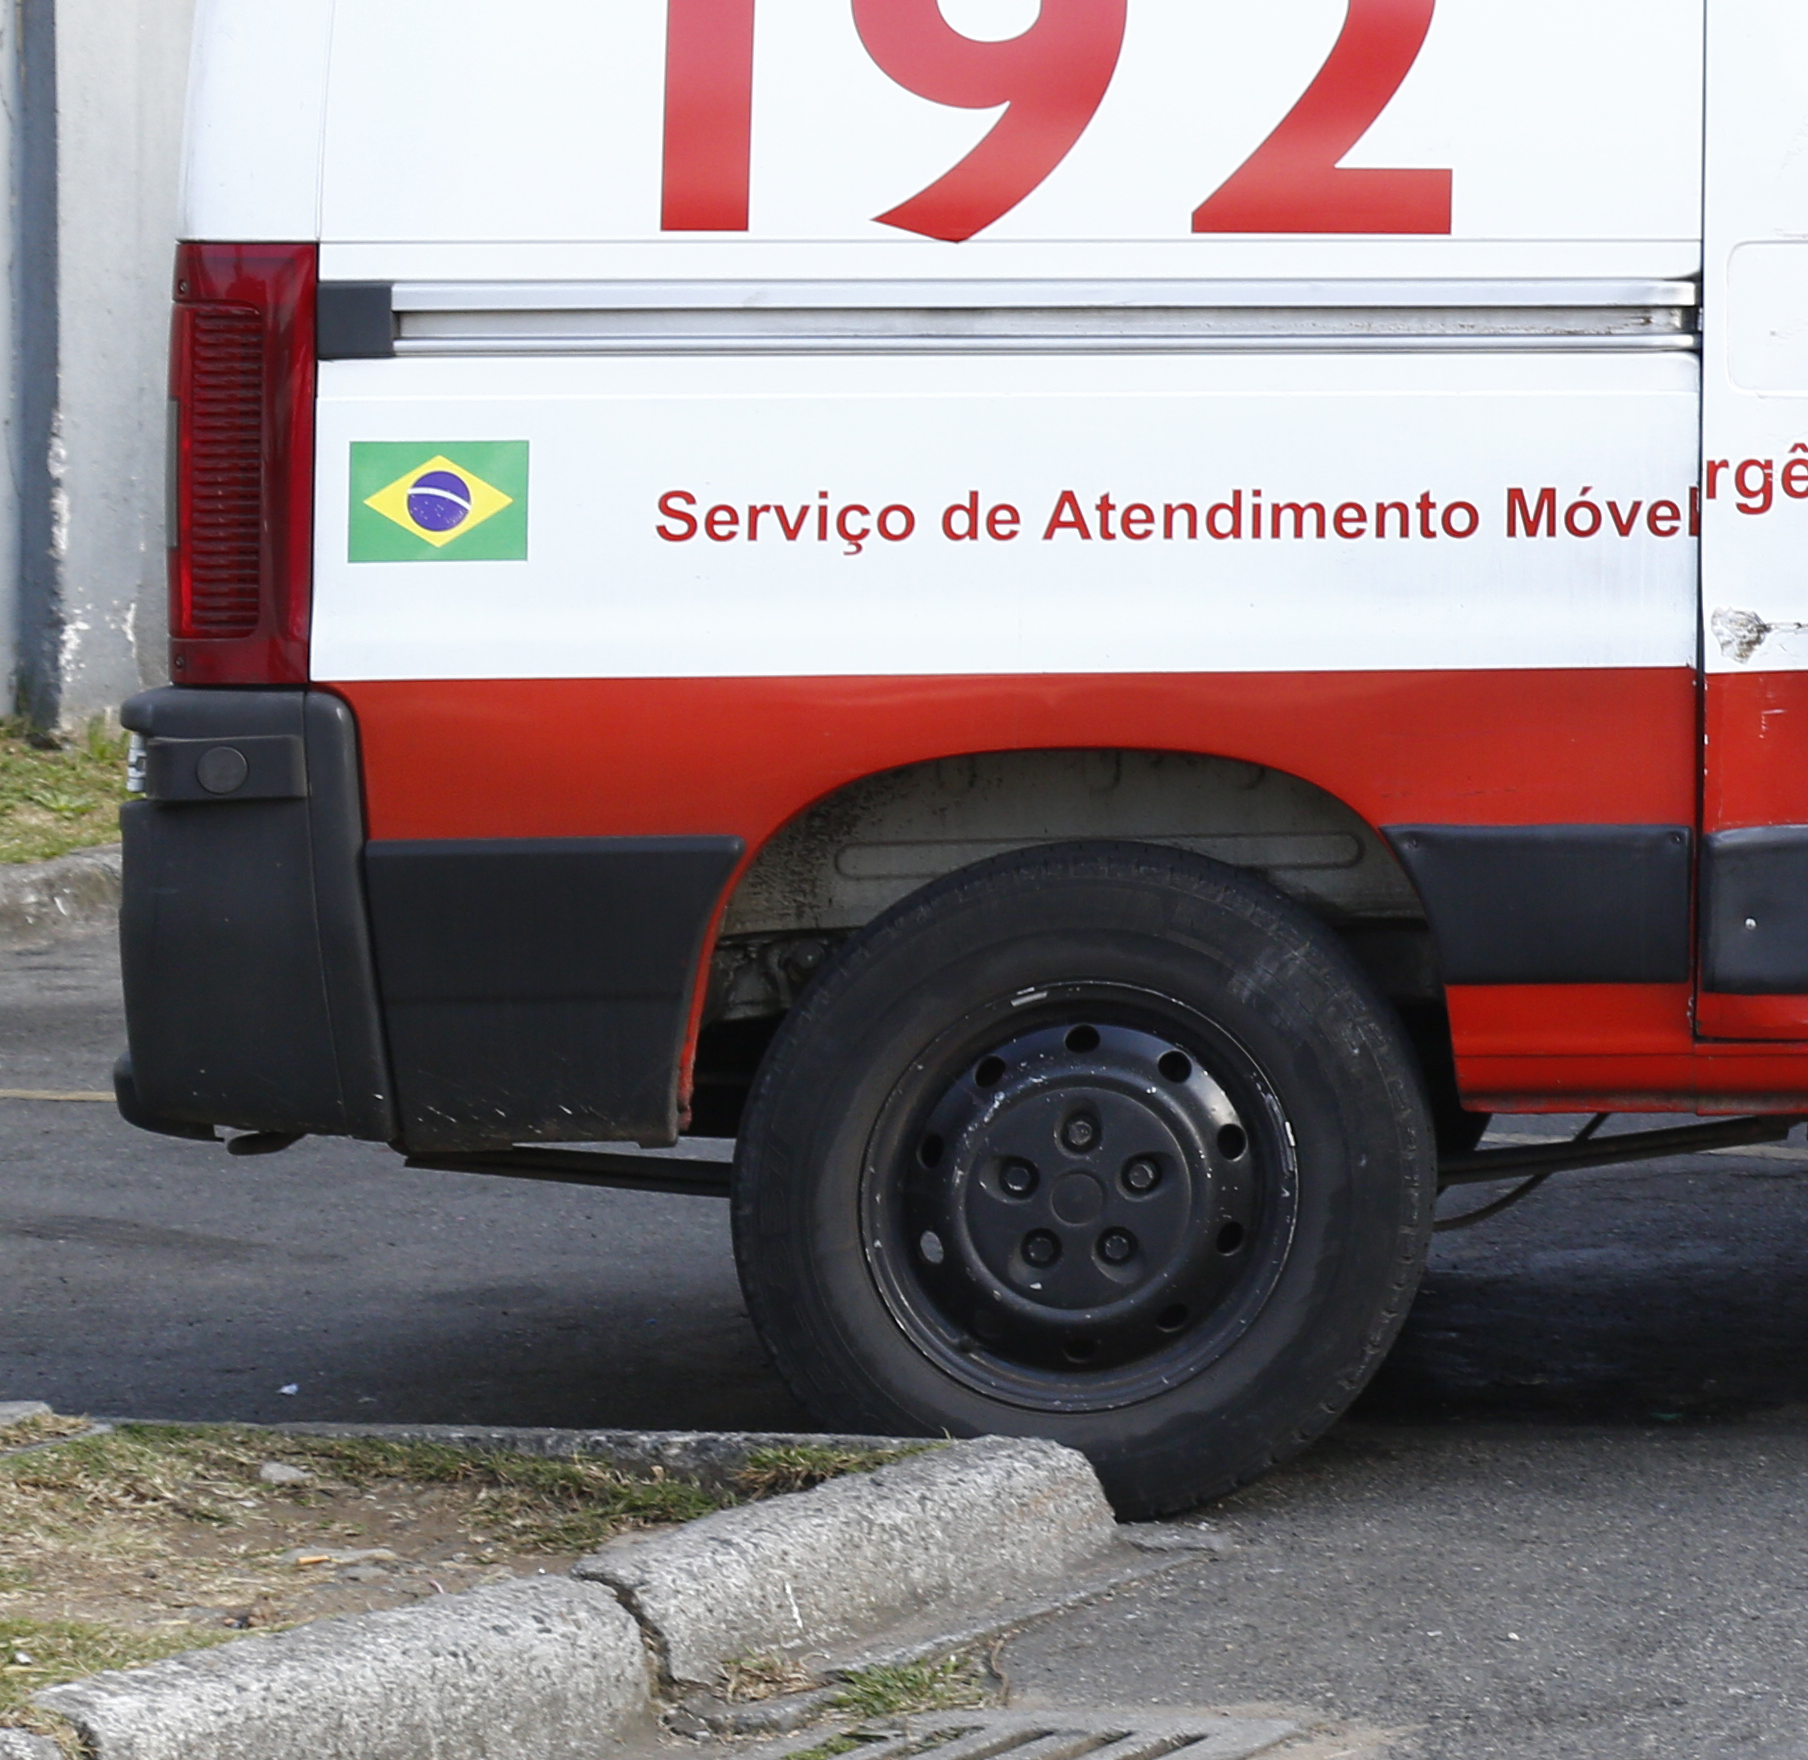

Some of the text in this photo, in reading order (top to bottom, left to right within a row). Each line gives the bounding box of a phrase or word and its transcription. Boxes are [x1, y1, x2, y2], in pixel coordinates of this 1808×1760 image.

[656, 486, 1699, 555] Serviço de Atendimento Móvel
